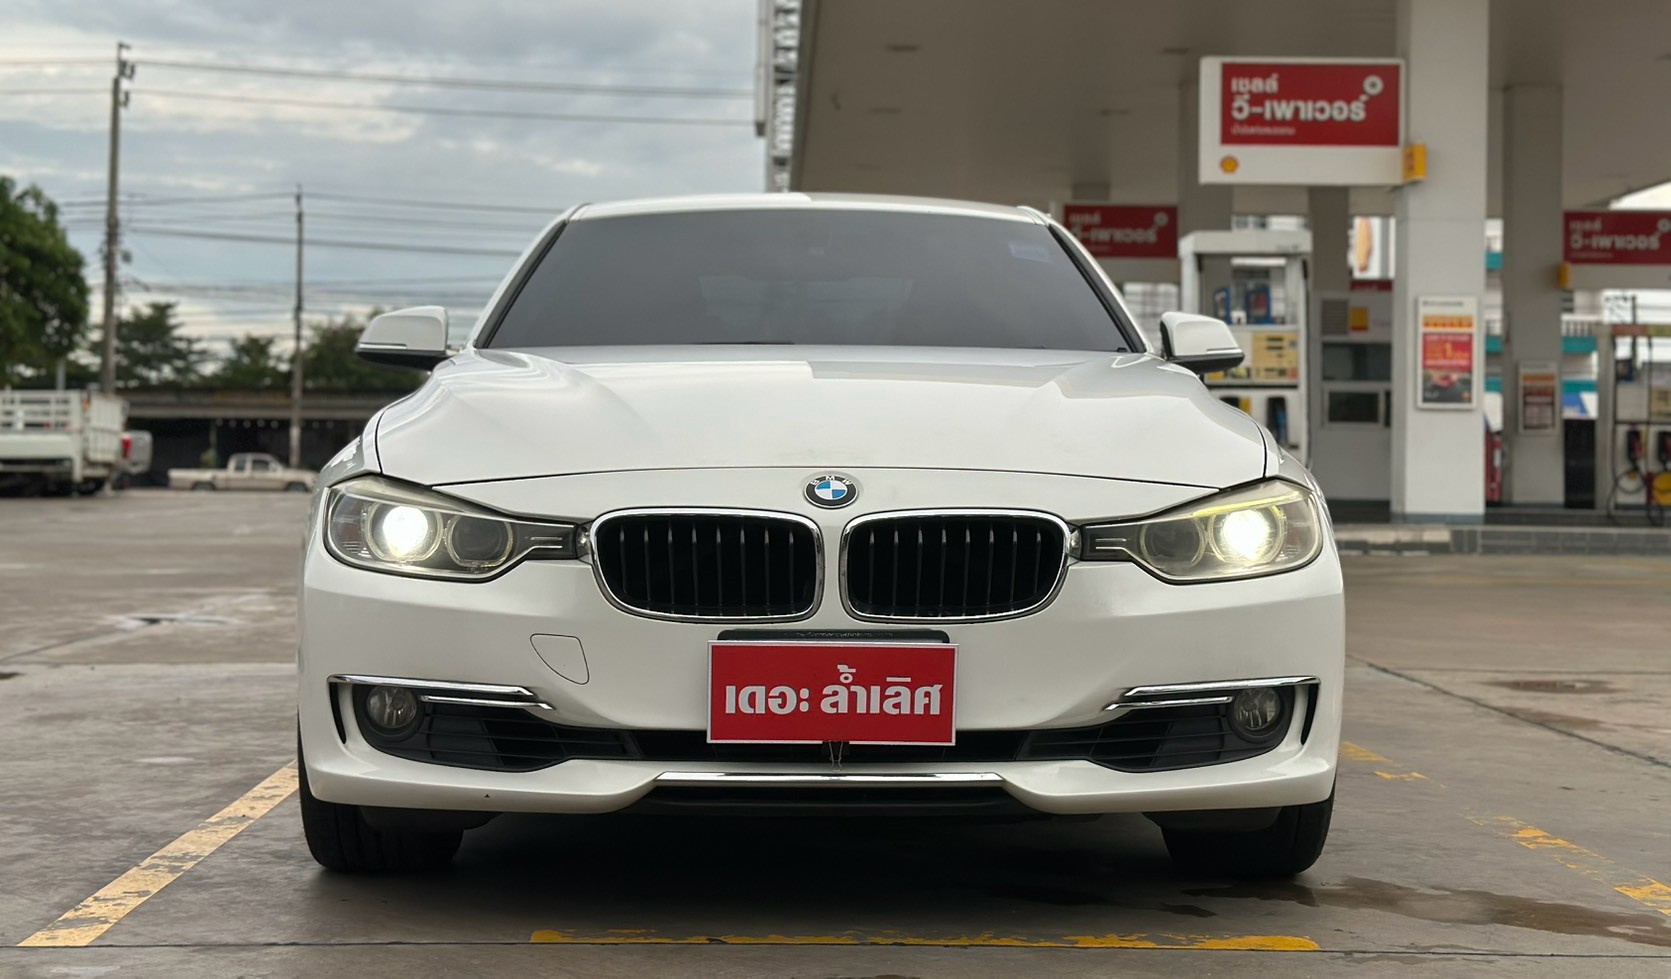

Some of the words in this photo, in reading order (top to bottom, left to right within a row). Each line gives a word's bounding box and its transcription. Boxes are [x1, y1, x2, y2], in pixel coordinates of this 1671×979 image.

[1231, 73, 1279, 93] เชลล์
[1230, 92, 1371, 122] วี-เพาเวอร์
[810, 475, 852, 486] BMW
[725, 685, 810, 715] เดอะ
[820, 664, 943, 715] ล้ำเลิศ
